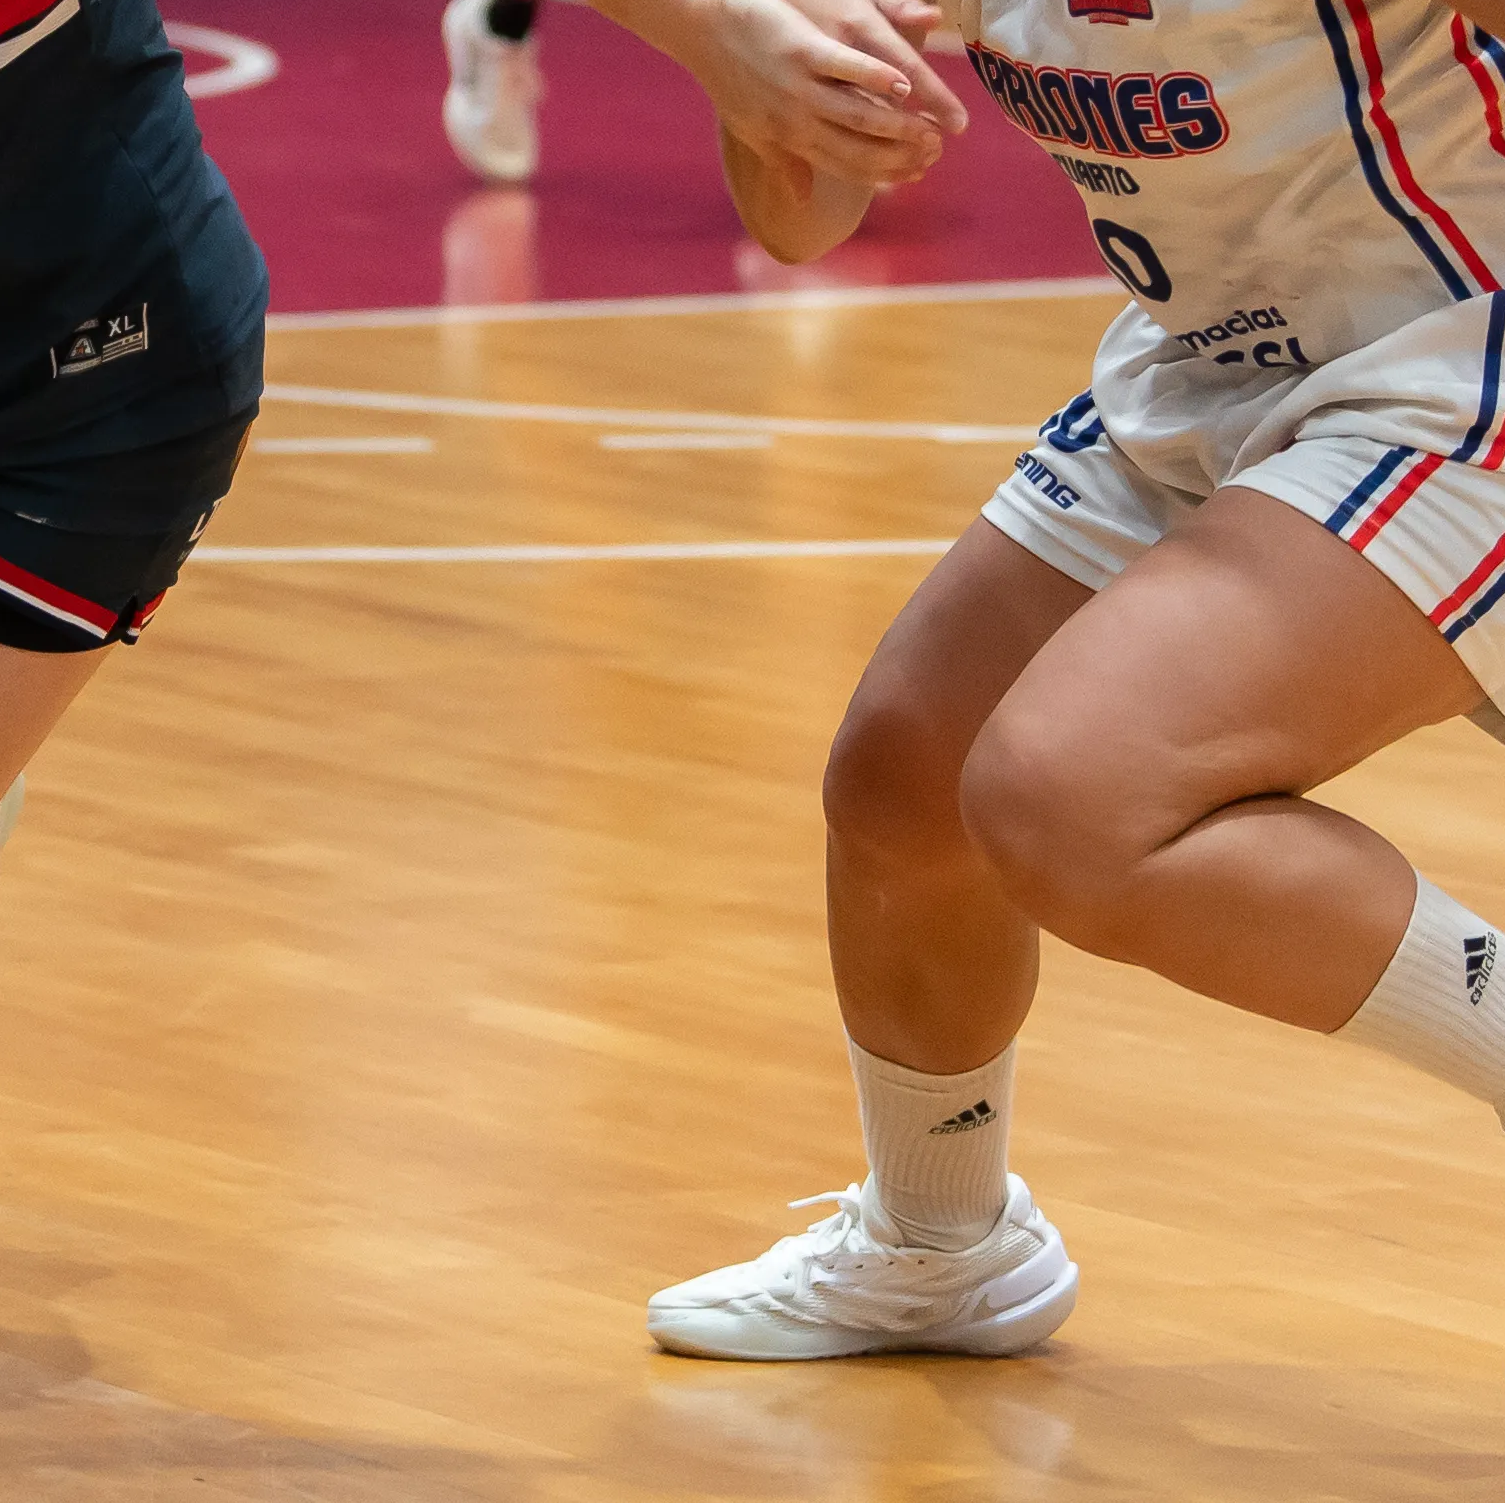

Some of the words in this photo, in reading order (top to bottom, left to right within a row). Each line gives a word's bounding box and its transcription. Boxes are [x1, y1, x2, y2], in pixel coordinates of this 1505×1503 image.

[107, 315, 136, 337] XL
[1469, 931, 1498, 1006] adidas
[927, 1109, 997, 1135] adidas
